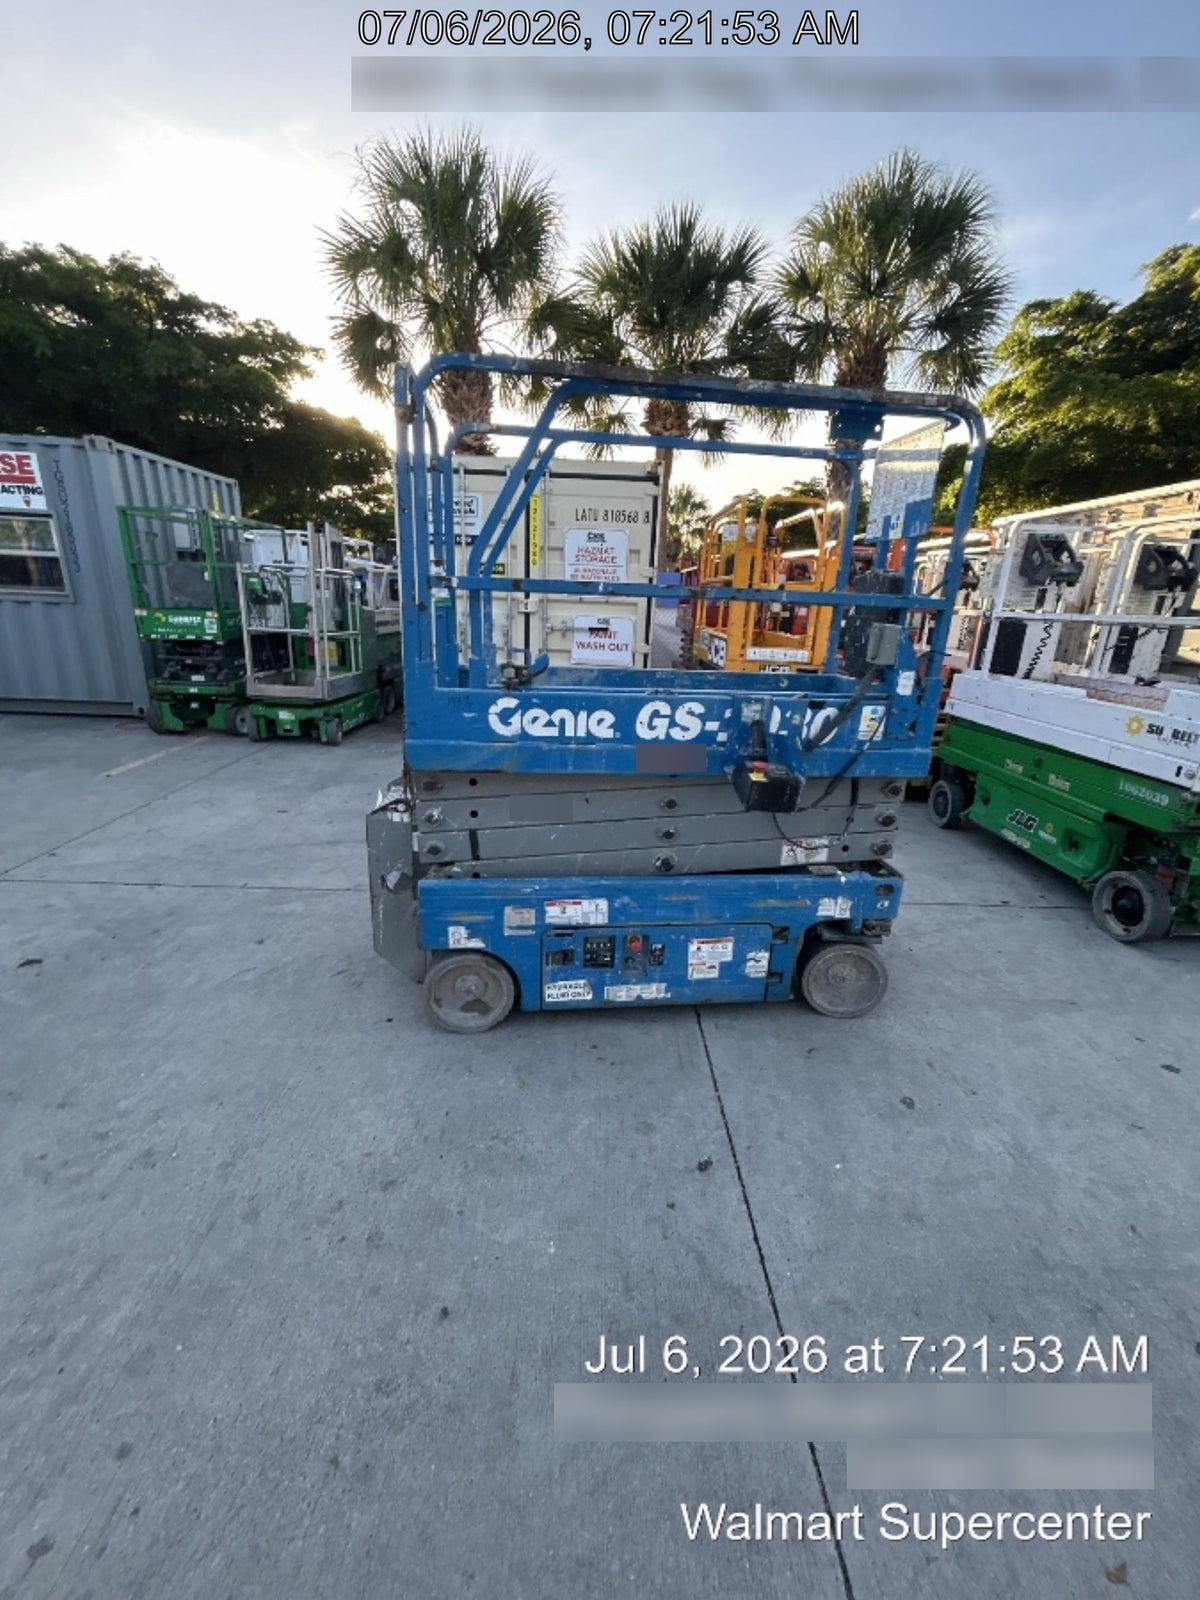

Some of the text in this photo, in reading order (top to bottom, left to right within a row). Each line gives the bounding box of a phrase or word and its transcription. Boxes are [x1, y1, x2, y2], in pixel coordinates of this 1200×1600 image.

[576, 508, 598, 522] LATU
[575, 554, 618, 564] STORAGE
[576, 640, 630, 652] WASH OUT
[488, 697, 615, 738] Genie
[635, 701, 839, 745] GS-0
[1146, 722, 1200, 745] SUBELT
[1006, 808, 1039, 833] JLG
